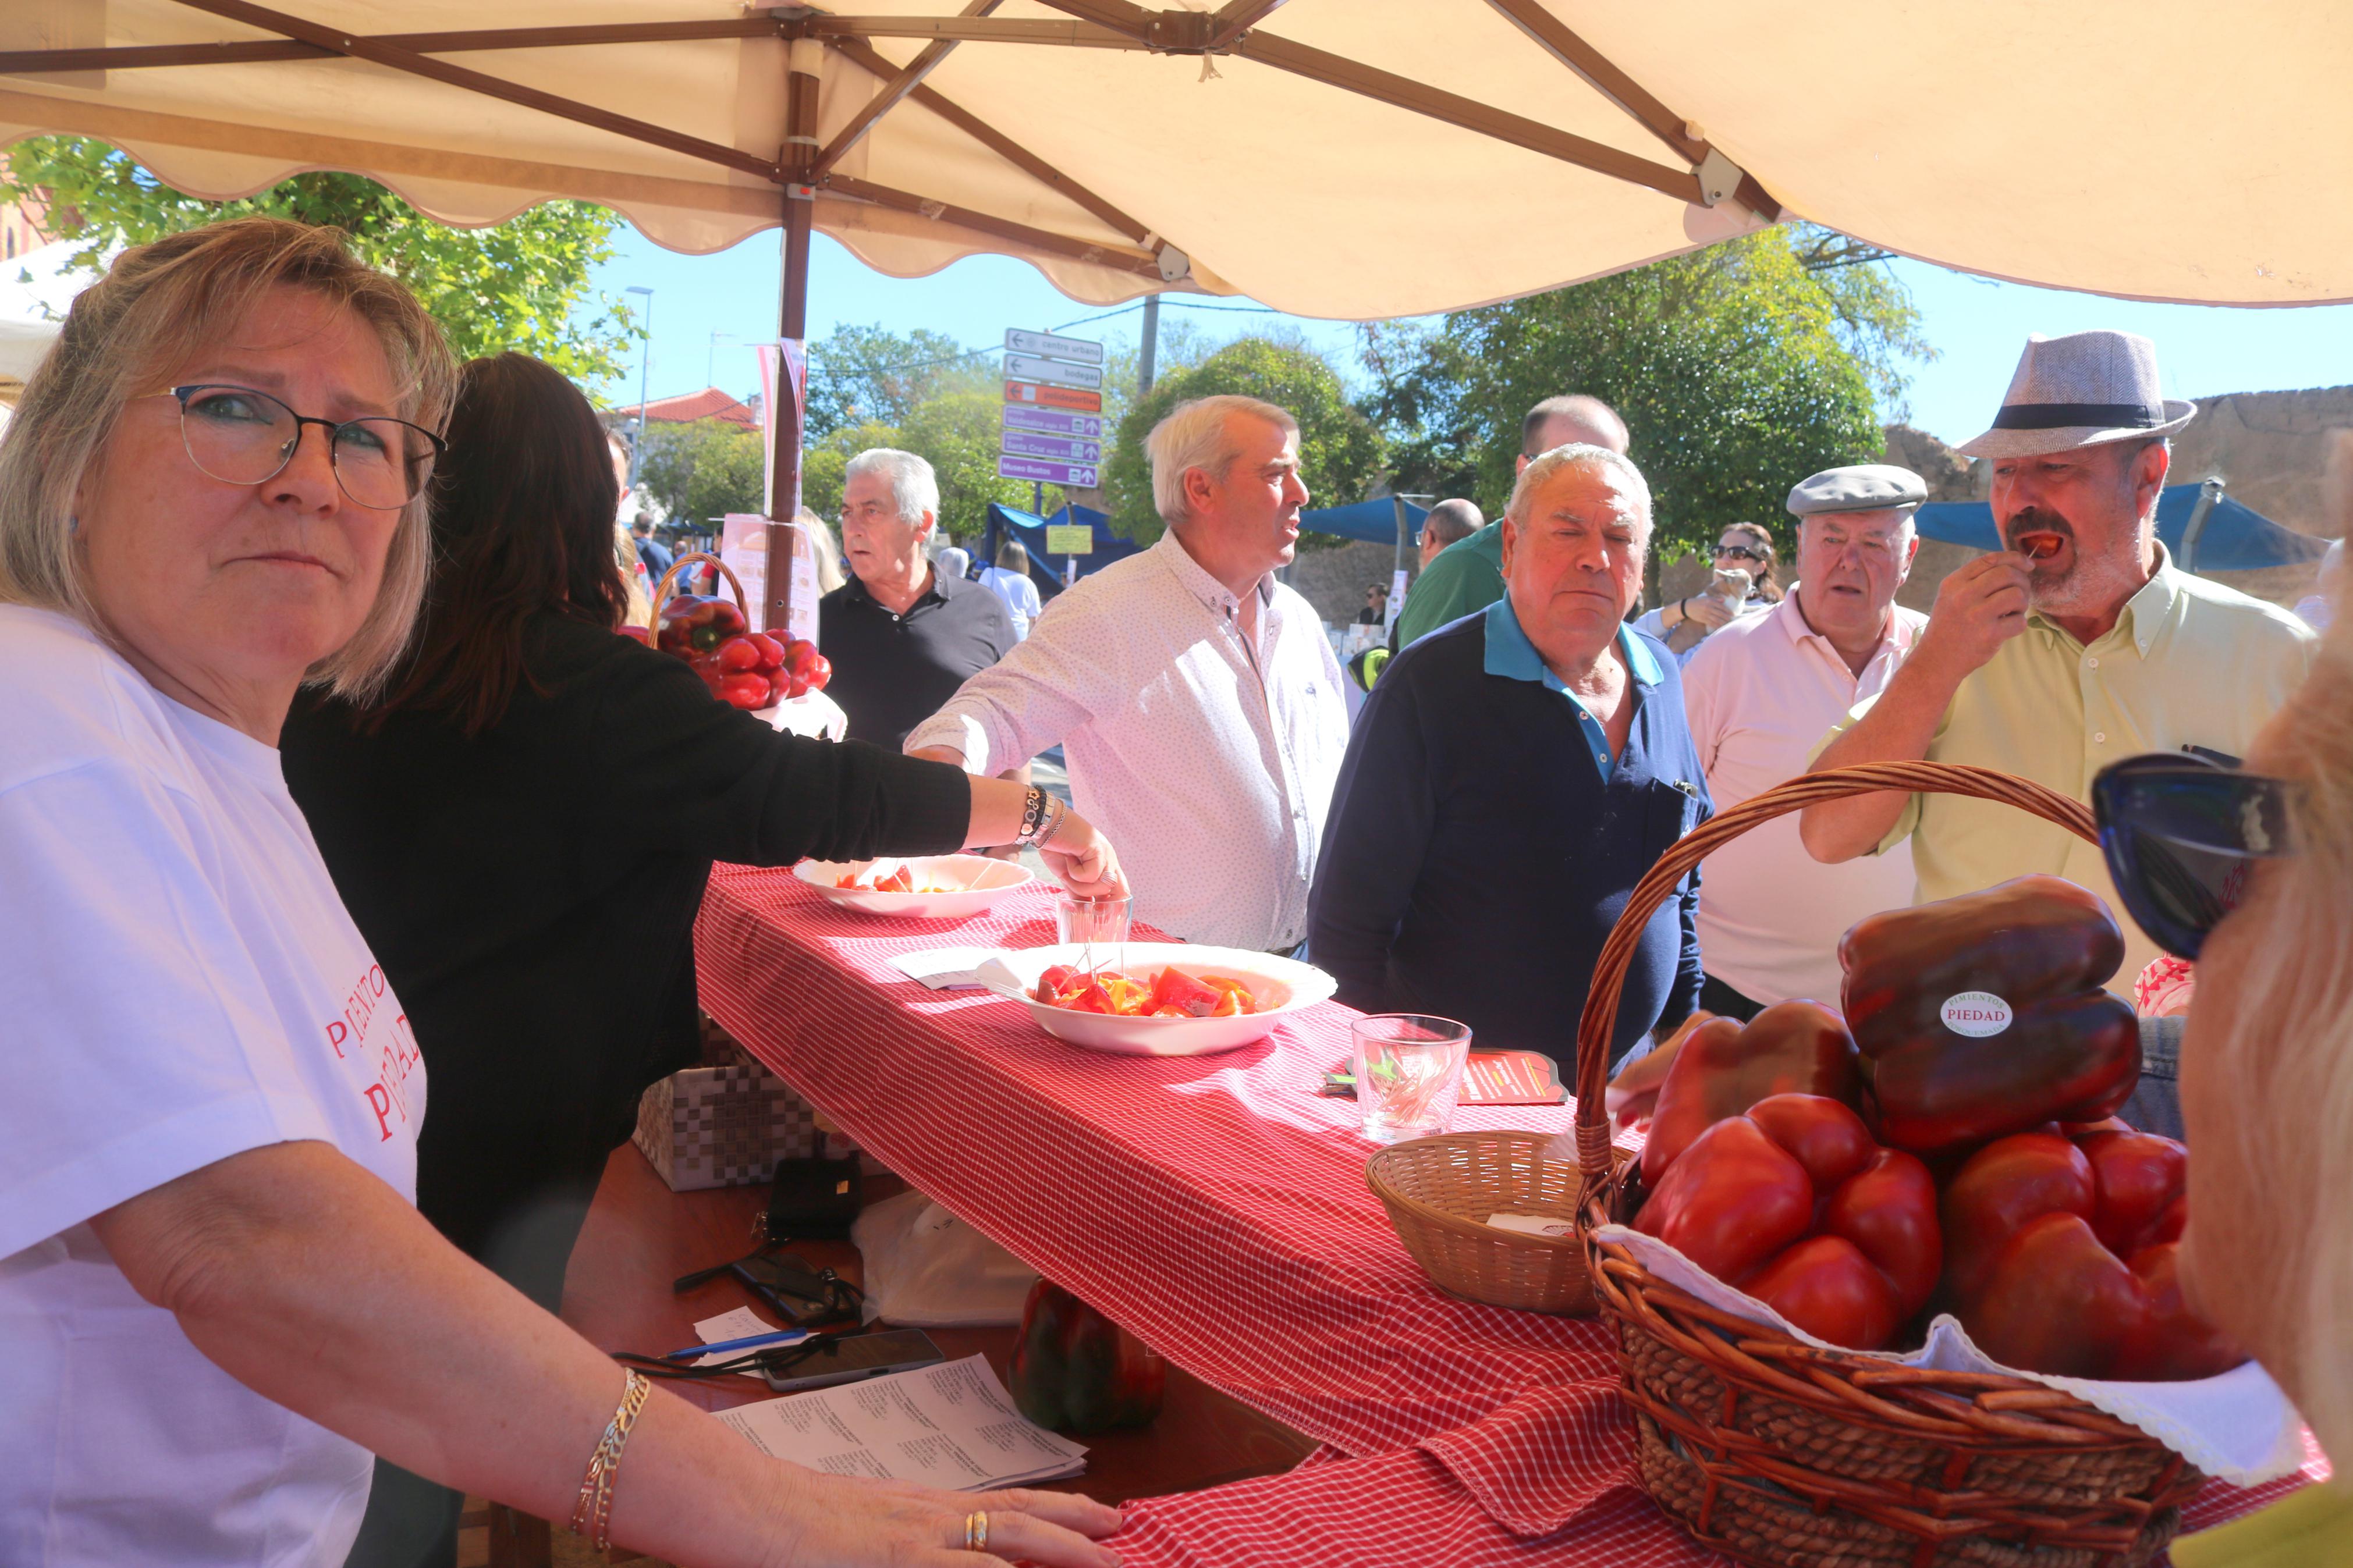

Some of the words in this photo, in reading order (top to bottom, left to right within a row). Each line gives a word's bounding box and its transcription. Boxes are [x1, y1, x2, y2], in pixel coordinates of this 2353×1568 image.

[1042, 342, 1069, 351] centro
[1072, 346, 1099, 356] urbano
[1064, 368, 1098, 382] bodegas
[1044, 392, 1100, 406] polideportivo
[1006, 441, 1027, 451] Santa
[1028, 444, 1045, 453] Cruz
[1003, 462, 1026, 473] Museo
[1027, 465, 1050, 475] Bustos
[1948, 993, 2004, 1009] PIMIENTOS
[1947, 1009, 2006, 1022] PIEDAD
[1946, 1021, 2006, 1036] TORQUEMADA
